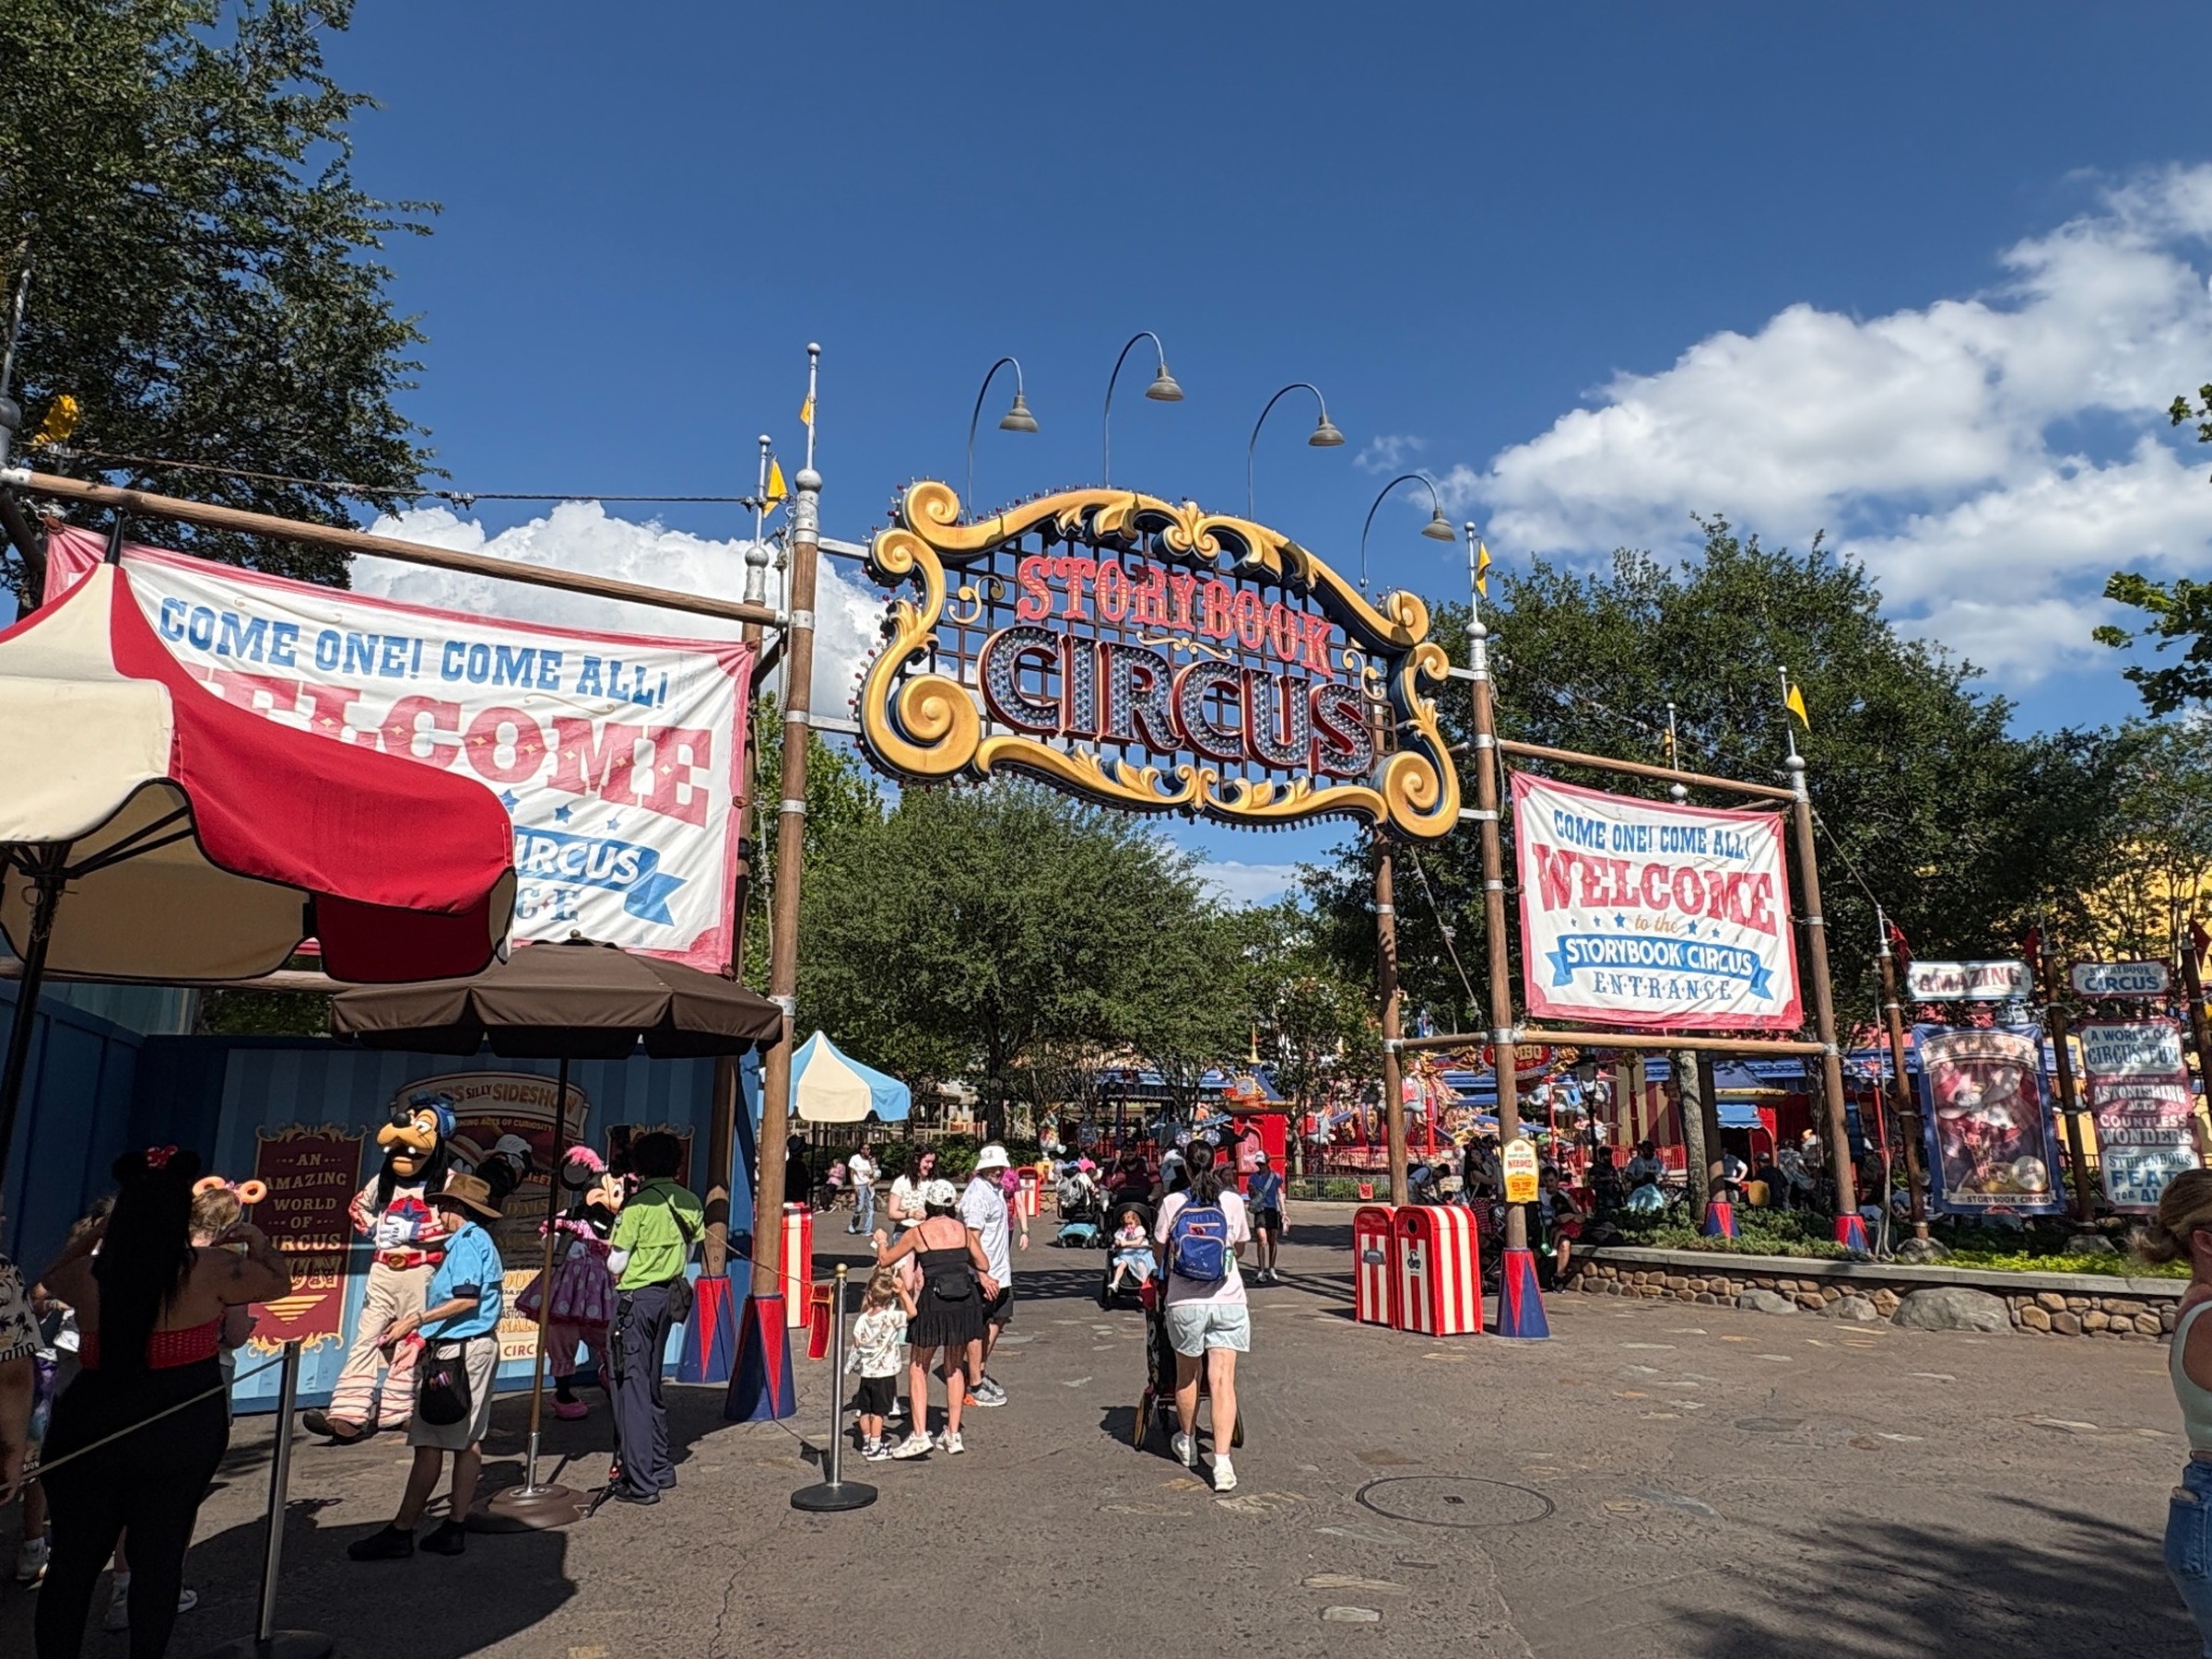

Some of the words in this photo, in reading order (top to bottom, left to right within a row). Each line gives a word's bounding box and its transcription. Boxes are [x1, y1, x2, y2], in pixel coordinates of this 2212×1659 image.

[1015, 555, 1334, 679] STORYBOOK
[159, 597, 299, 666] COME
[314, 630, 420, 681] ONE!
[441, 641, 562, 693] COME
[576, 657, 668, 708] ALL!
[979, 625, 1375, 779] CIRCUS
[1553, 809, 1606, 848] COME
[1613, 825, 1653, 853] ONE!
[1660, 827, 1706, 854] COME
[1713, 830, 1751, 860] ALL!
[514, 834, 642, 885] IRCUS
[1532, 841, 1777, 937] WELCOME
[1634, 914, 1650, 932] to
[1654, 912, 1679, 934] the
[1566, 938, 1682, 967] STORYBOOK
[1687, 946, 1753, 975] CIRCUS
[2089, 965, 2151, 977] STORYBOOK
[1919, 968, 2022, 992] AMAZING
[2085, 976, 2159, 991] CIRCUS
[2091, 1030, 2100, 1041] A
[2102, 1030, 2148, 1041] WORLD
[2153, 1029, 2169, 1040] OF
[2088, 1044, 2142, 1065] CIRCUS
[2147, 1043, 2179, 1063] FUN
[465, 1084, 493, 1100] SILLY
[2094, 1084, 2186, 1105] ASTONISHING
[2127, 1100, 2156, 1112] ACTS
[501, 1118, 512, 1126] OF
[2100, 1113, 2187, 1127] COUNTLESS
[2099, 1128, 2194, 1145] WONDERS
[297, 1153, 322, 1166] AN
[2109, 1152, 2192, 1169] STUPENDOUS
[265, 1171, 347, 1190] AMAZING
[2111, 1171, 2178, 1187] FEAT
[1967, 1195, 2017, 1204] STORYBOOK
[2115, 1191, 2136, 1200] FOR
[273, 1198, 337, 1211] WORLD
[290, 1217, 313, 1229] OF
[266, 1233, 342, 1252] IRCUS
[284, 1254, 343, 1290] UN
[504, 1344, 535, 1357] CIRC
